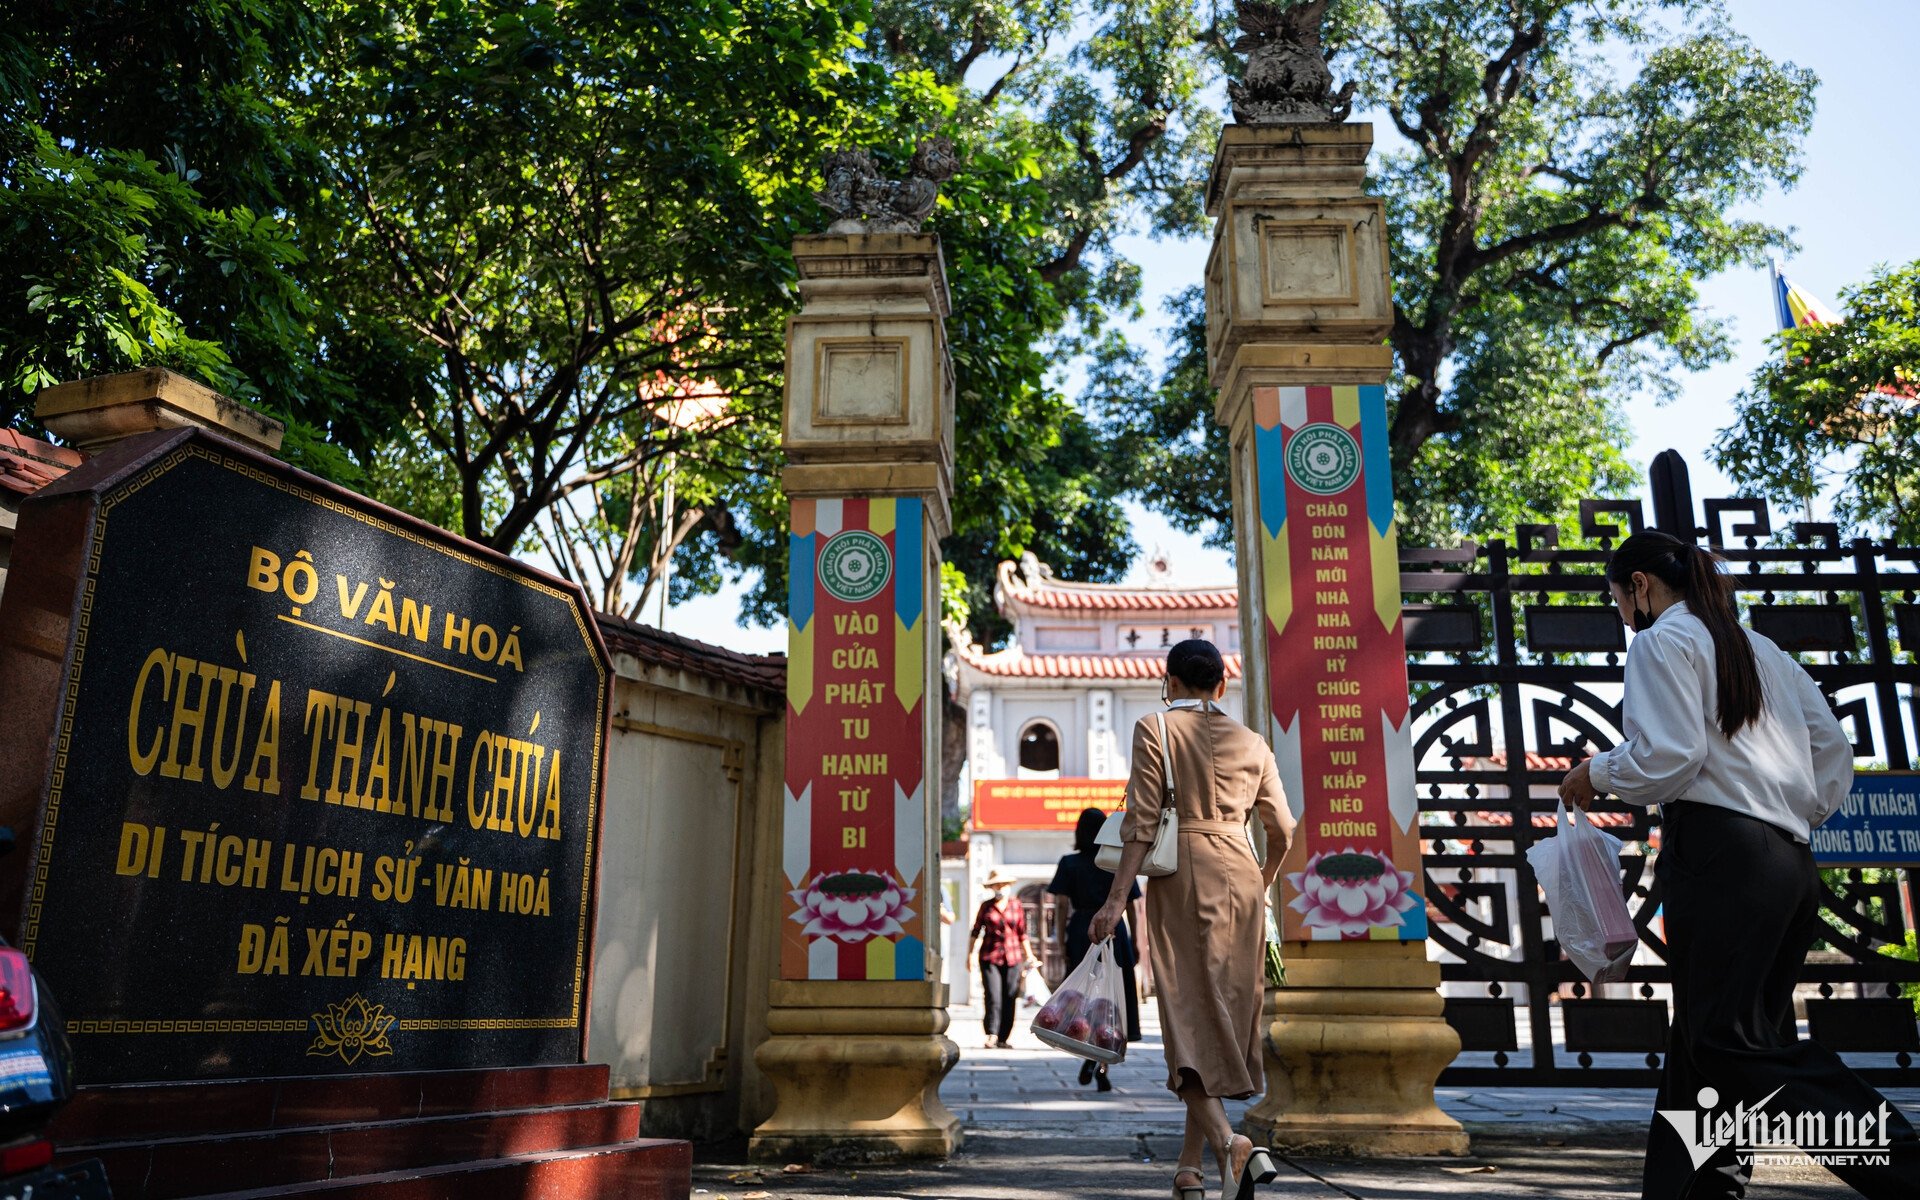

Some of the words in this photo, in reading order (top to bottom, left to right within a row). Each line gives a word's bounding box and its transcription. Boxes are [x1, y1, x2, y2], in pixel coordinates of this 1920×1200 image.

[1324, 474, 1344, 487] NAM
[1306, 501, 1348, 517] CHÀO
[1312, 523, 1345, 538] ĐÓN
[1312, 545, 1348, 560] NĂM
[1316, 566, 1347, 582] MỚI
[854, 582, 873, 594] NAM
[1316, 588, 1349, 604] NHÀ
[247, 546, 319, 617] BỘ
[336, 577, 431, 643] VĂN
[443, 612, 524, 673] HOÁ
[1317, 610, 1350, 627] NHÀ
[834, 610, 879, 635] VÀO
[1314, 636, 1357, 650] HOAN
[832, 641, 879, 669] CỬA
[1327, 654, 1346, 672] HỶ
[825, 679, 885, 709] PHẬT
[1317, 679, 1360, 695] CHÚC
[1319, 704, 1362, 722] TỤNG
[128, 630, 282, 795] CHÙA
[300, 671, 462, 823] THÁNH
[467, 711, 562, 841] CHÚA
[841, 719, 870, 739] TU
[822, 754, 888, 780] HẠNH
[1330, 751, 1357, 765] VUI
[838, 785, 870, 812] TỪ
[1330, 793, 1363, 813] NẺO
[1868, 788, 1917, 816] KHÁCH
[842, 827, 866, 848] BI
[1320, 818, 1377, 838] ĐƯỜNG
[1853, 821, 1874, 853] ĐỖ
[1876, 829, 1897, 853] XE
[115, 822, 166, 878] DI
[180, 822, 271, 889] TÍCH
[280, 843, 363, 905] LỊCH
[499, 868, 551, 917] HOÁ
[237, 915, 290, 975] ĐÃ
[301, 912, 372, 977] XẾP
[381, 934, 467, 990] HẠNG
